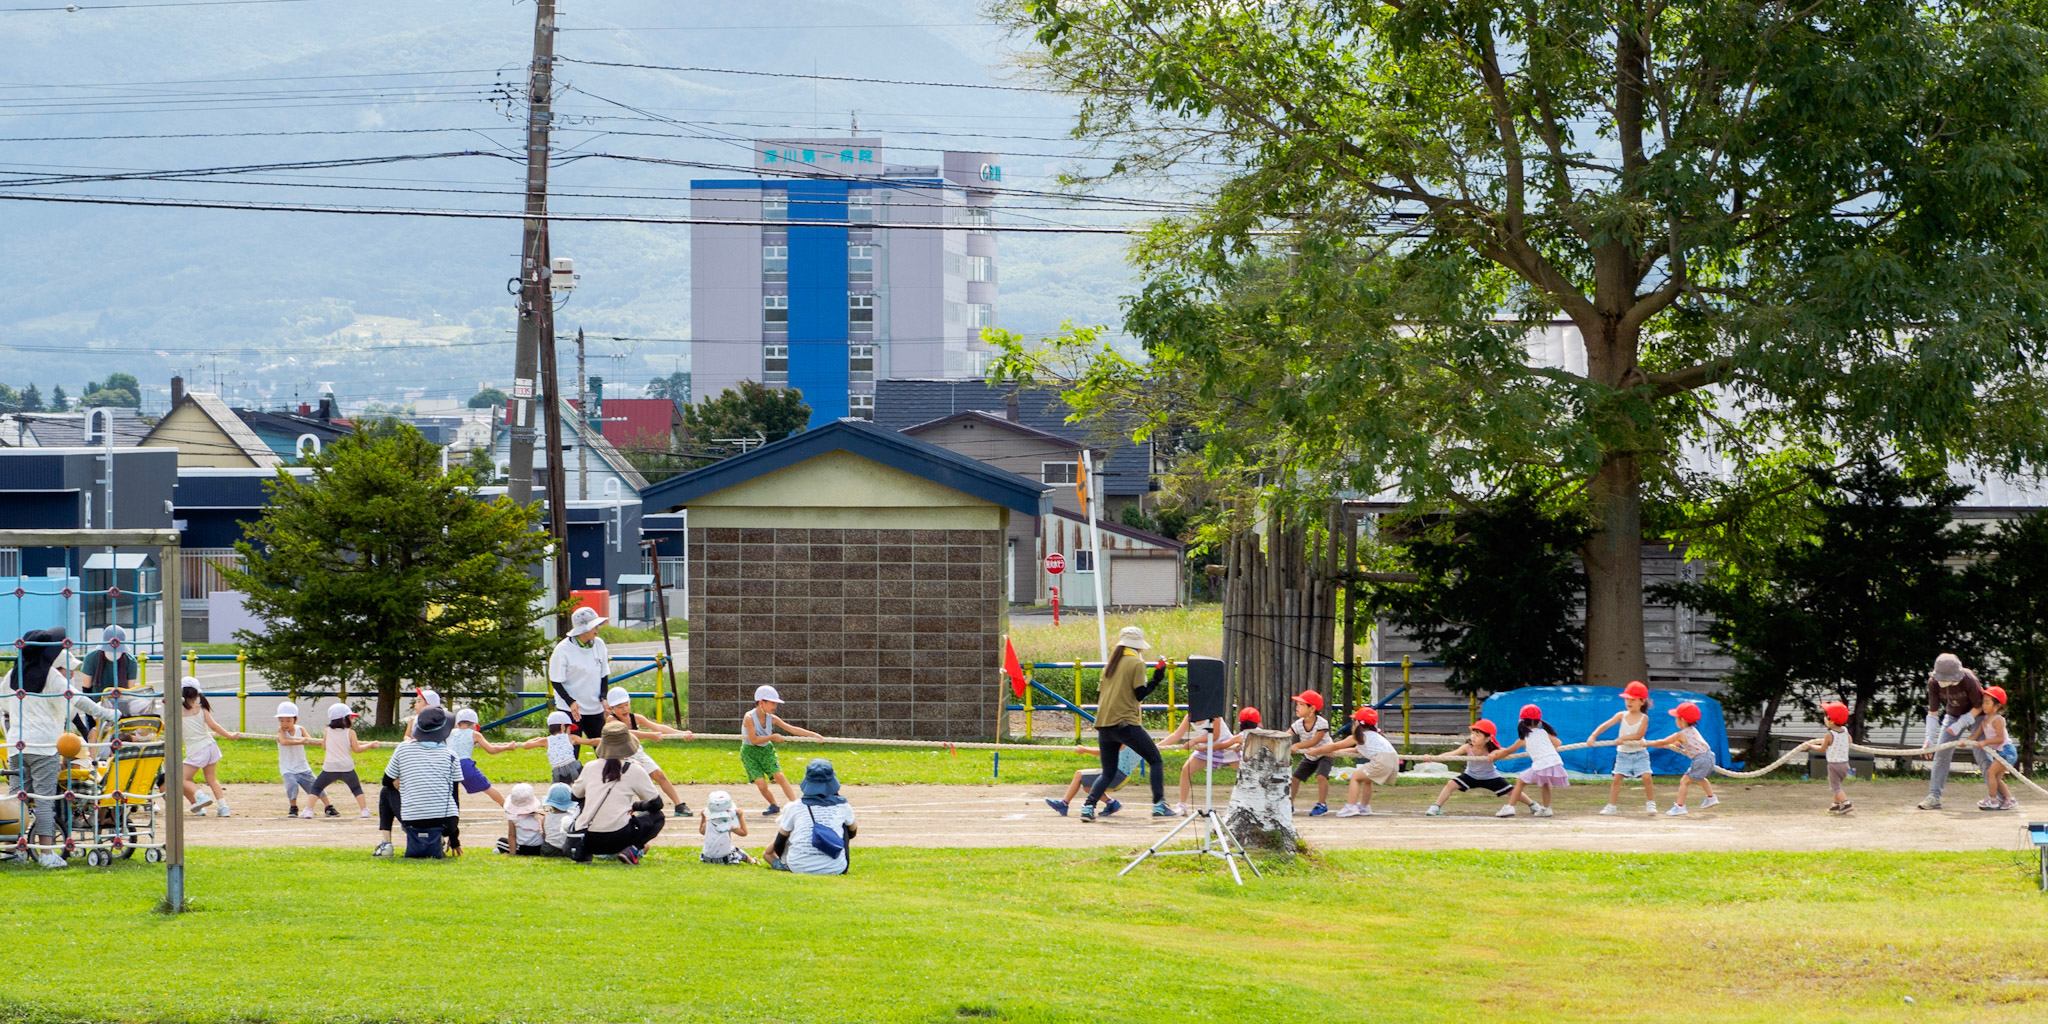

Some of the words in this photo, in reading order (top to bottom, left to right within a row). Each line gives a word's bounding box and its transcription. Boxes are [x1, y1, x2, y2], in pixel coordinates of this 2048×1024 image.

[763, 149, 873, 164] 深川第一病院
